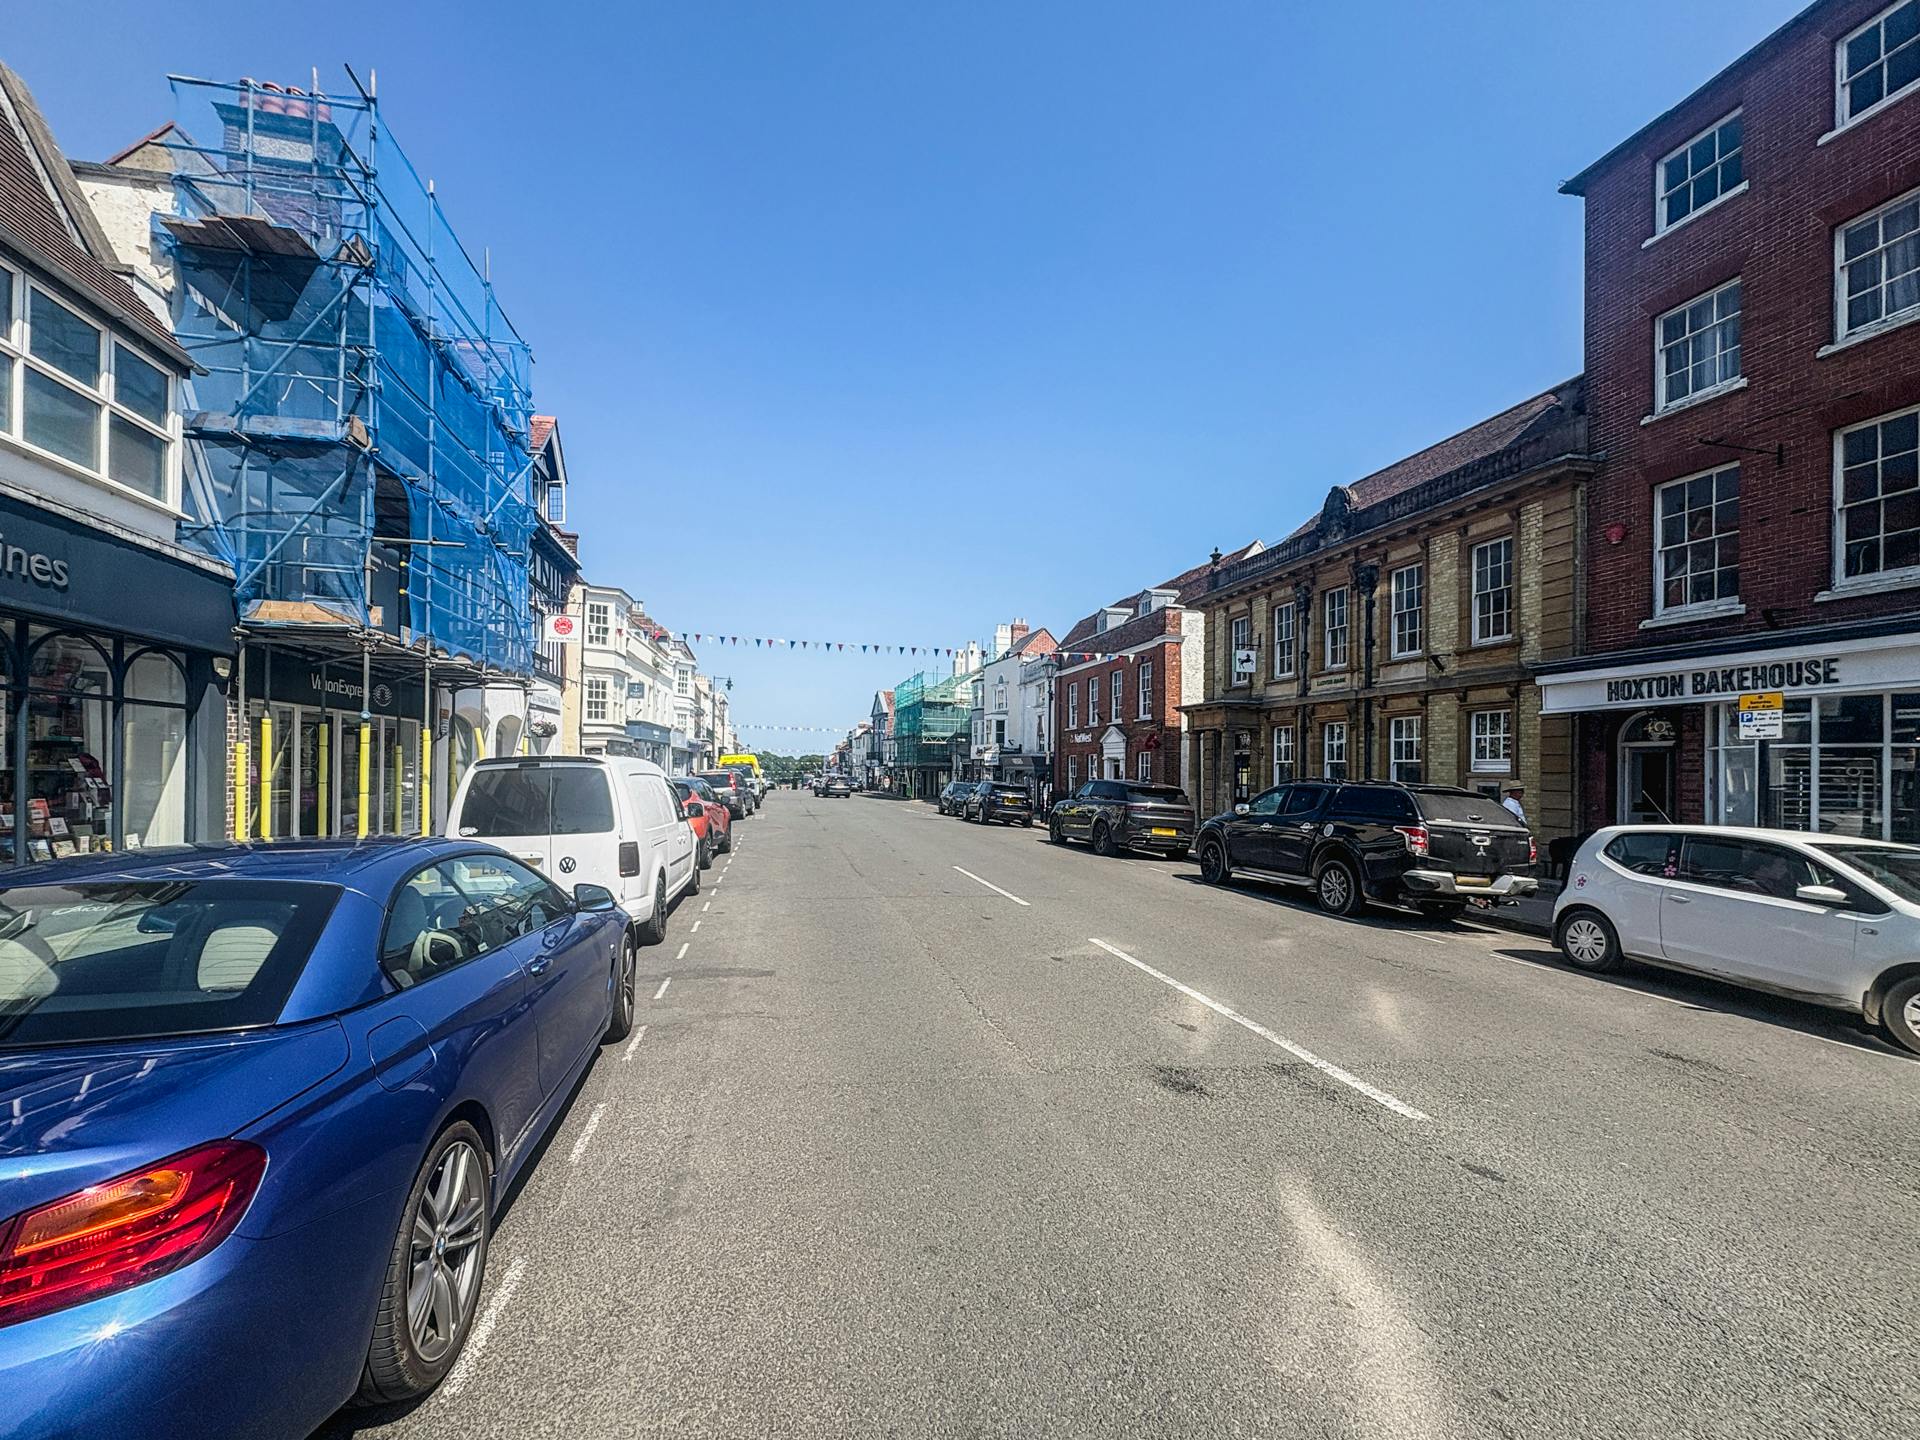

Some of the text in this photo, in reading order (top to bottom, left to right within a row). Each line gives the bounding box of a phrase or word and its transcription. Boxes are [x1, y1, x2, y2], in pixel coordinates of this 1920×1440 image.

[311, 673, 364, 699] ViionExpre
[1607, 658, 1840, 701] HOXTON BAKEHOUSE
